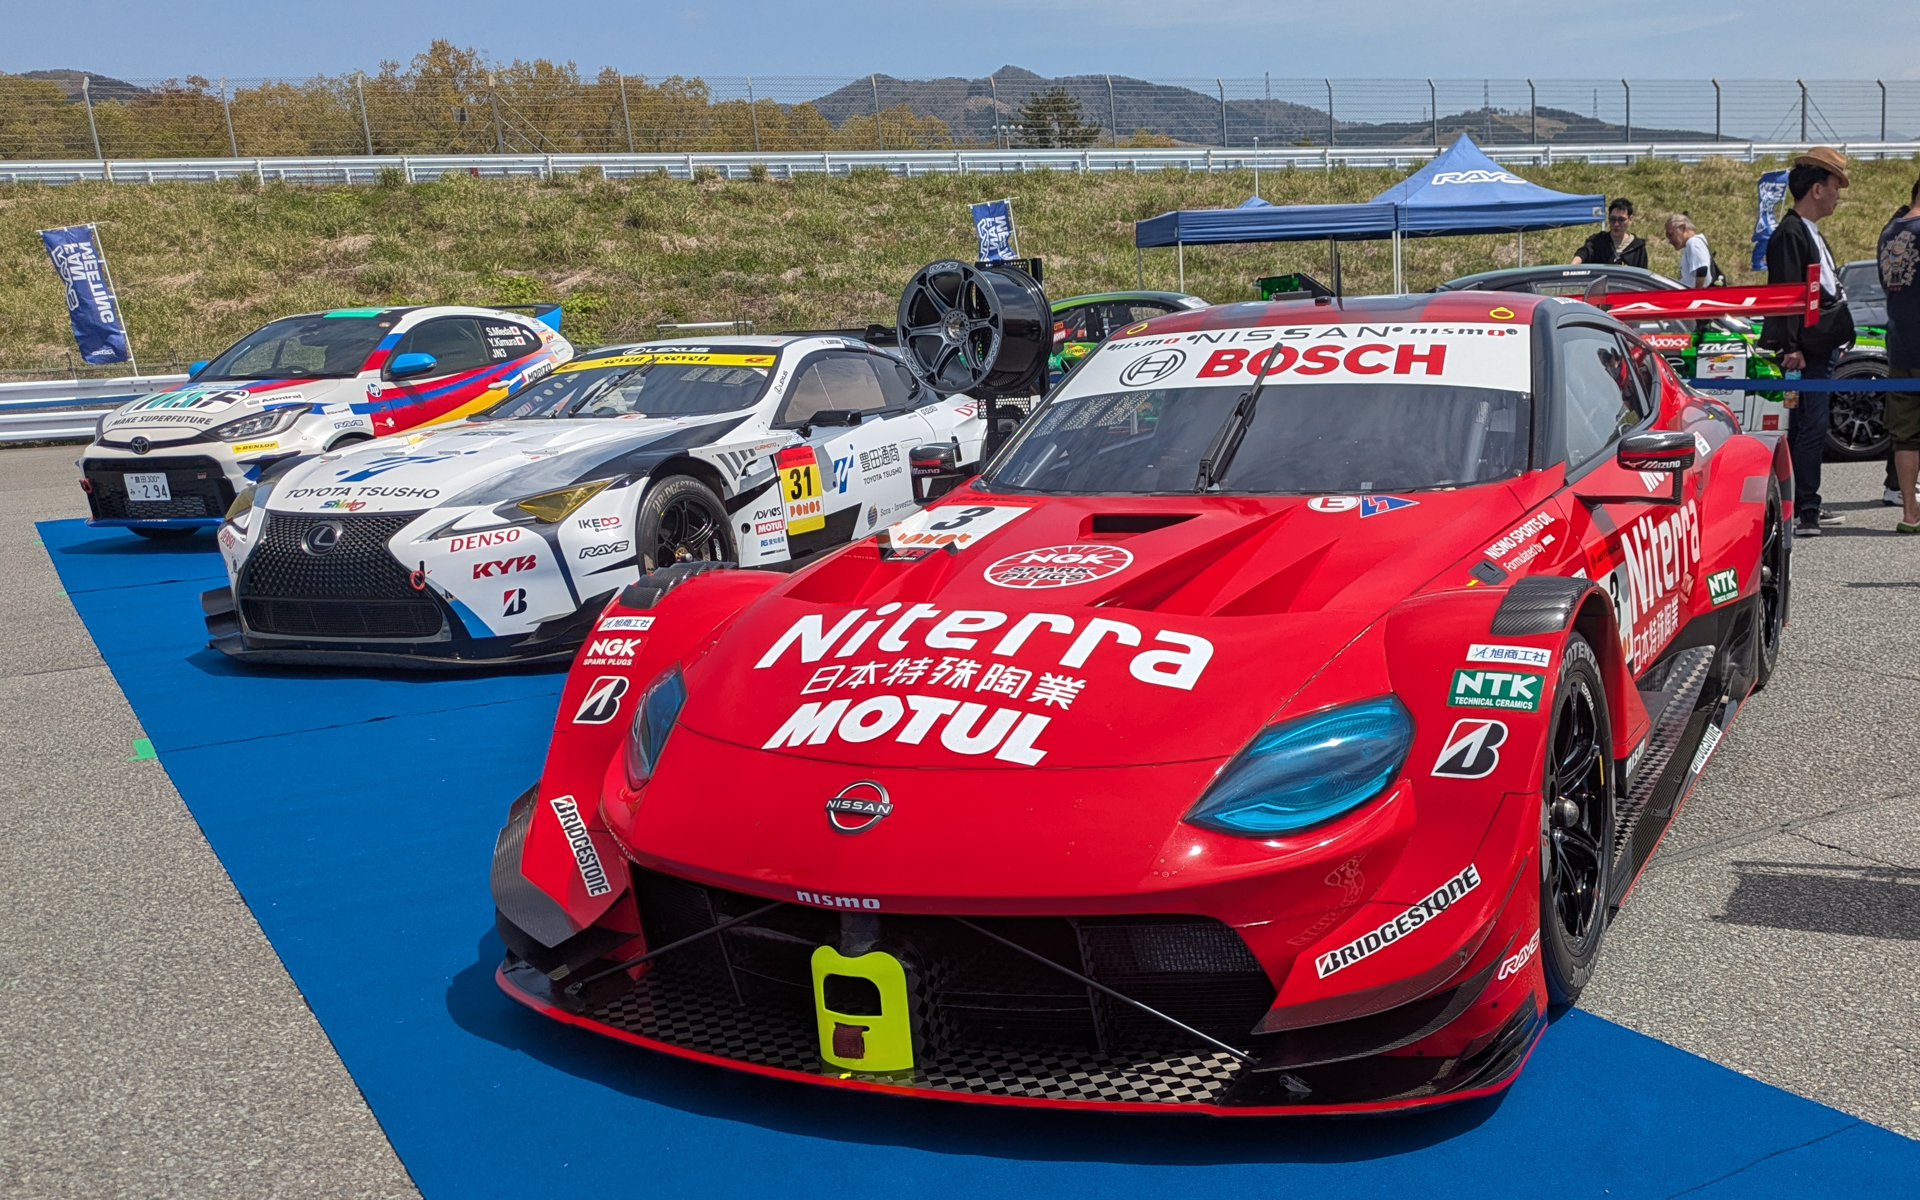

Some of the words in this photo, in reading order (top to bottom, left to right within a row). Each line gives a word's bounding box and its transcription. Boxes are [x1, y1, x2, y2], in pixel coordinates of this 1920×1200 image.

[1432, 170, 1527, 185] RAYS
[929, 262, 959, 274] RAYS
[1111, 337, 1181, 351] nismo
[1193, 326, 1390, 345] NISSAN
[1409, 327, 1506, 337] nismo
[492, 348, 507, 358] JN3
[984, 333, 1001, 370] RAYS
[1196, 343, 1447, 378] BOSCH
[902, 346, 923, 377] RAYS
[527, 363, 552, 383] MORIZO
[261, 394, 302, 403] Admiral
[111, 416, 137, 427] MAKE
[137, 414, 214, 426] SUPERFUTURE
[334, 420, 364, 429] RAYS
[241, 442, 276, 451] DUNLOP
[789, 466, 813, 500] 31
[863, 472, 883, 485] TOYOTA
[883, 467, 903, 479] TSUSHO
[285, 487, 353, 499] TOYOTA
[357, 487, 440, 499] TSUSHO
[753, 507, 782, 520] ADVICS
[789, 500, 821, 518] PONOS
[880, 506, 892, 517] Sora
[930, 507, 995, 530] 3
[578, 517, 620, 529] IKEDO
[757, 520, 783, 534] MOTUL
[220, 529, 236, 550] DENSO
[450, 529, 520, 552] DENSO
[1484, 536, 1518, 560] NISMO
[1509, 517, 1544, 544] SPORTS
[1537, 511, 1556, 529] OIL
[579, 540, 630, 560] RAYS
[1020, 553, 1114, 565] NGK
[1502, 545, 1538, 573] Formulated
[1534, 542, 1547, 553] by
[473, 554, 537, 580] KYB
[1009, 565, 1097, 574] SPARK
[1620, 499, 1701, 624] Niterra
[997, 571, 1087, 580] PLUGS
[1707, 569, 1737, 597] NTK
[614, 618, 650, 628] 旭商工社
[586, 638, 641, 657] NGK
[754, 602, 1215, 691] Niterra
[1490, 648, 1547, 663] 旭商工社
[583, 658, 606, 666] SPARK
[607, 658, 632, 666] PLUGS
[801, 656, 1086, 711] 日本特殊陶業
[1456, 672, 1538, 700] NTK
[1455, 696, 1494, 707] TECHNICAL
[1495, 698, 1533, 710] CERAMICS
[761, 695, 1053, 767] MOTUL
[826, 799, 891, 814] NISSAN
[551, 796, 611, 896] BRIDGESTONE
[796, 890, 881, 909] nismo
[1316, 864, 1481, 978] BRIDGESTONE
[1498, 927, 1540, 980] RAYS
